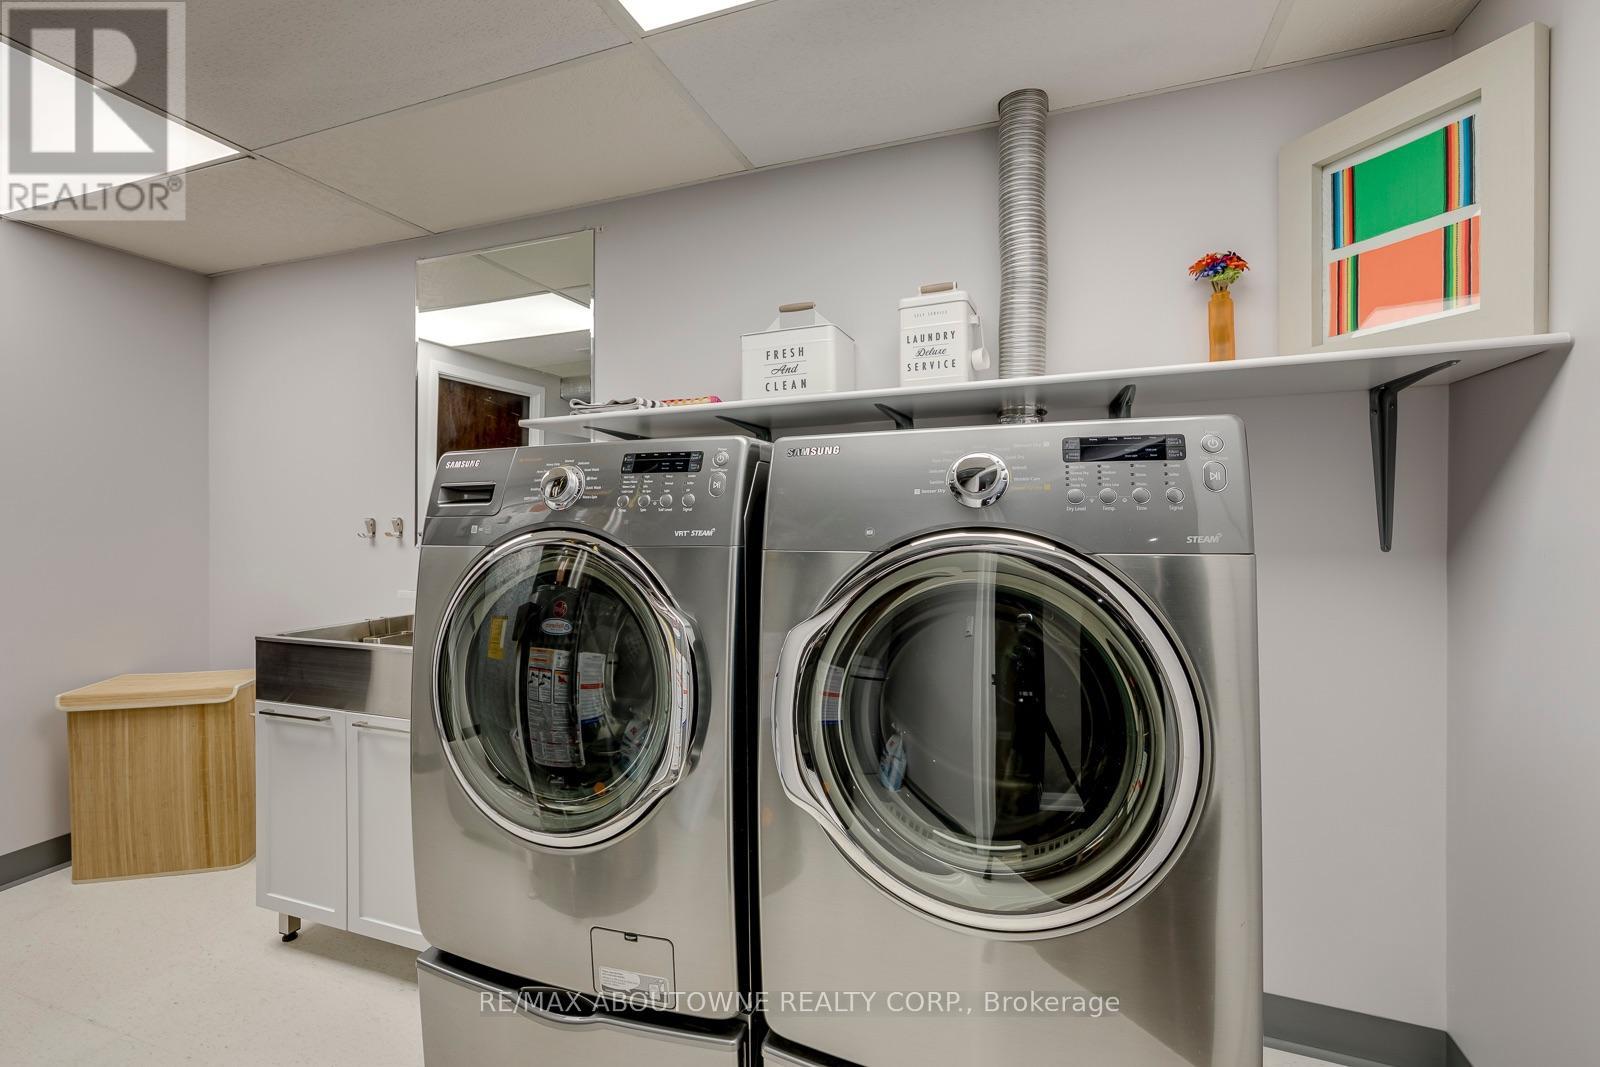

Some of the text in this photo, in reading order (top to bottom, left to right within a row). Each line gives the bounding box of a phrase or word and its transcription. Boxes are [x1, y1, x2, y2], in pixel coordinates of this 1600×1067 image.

[906, 330, 956, 344] LAUNDRY
[766, 346, 805, 361] FRESH
[914, 346, 947, 358] Deluxe
[770, 363, 799, 375] And
[907, 358, 957, 372] SERVICE
[765, 378, 808, 392] CLEAN
[787, 445, 840, 458] SAMSUNG
[445, 458, 481, 470] SAMSUNG
[690, 529, 713, 537] STEAM
[1186, 535, 1220, 544] STEAM
